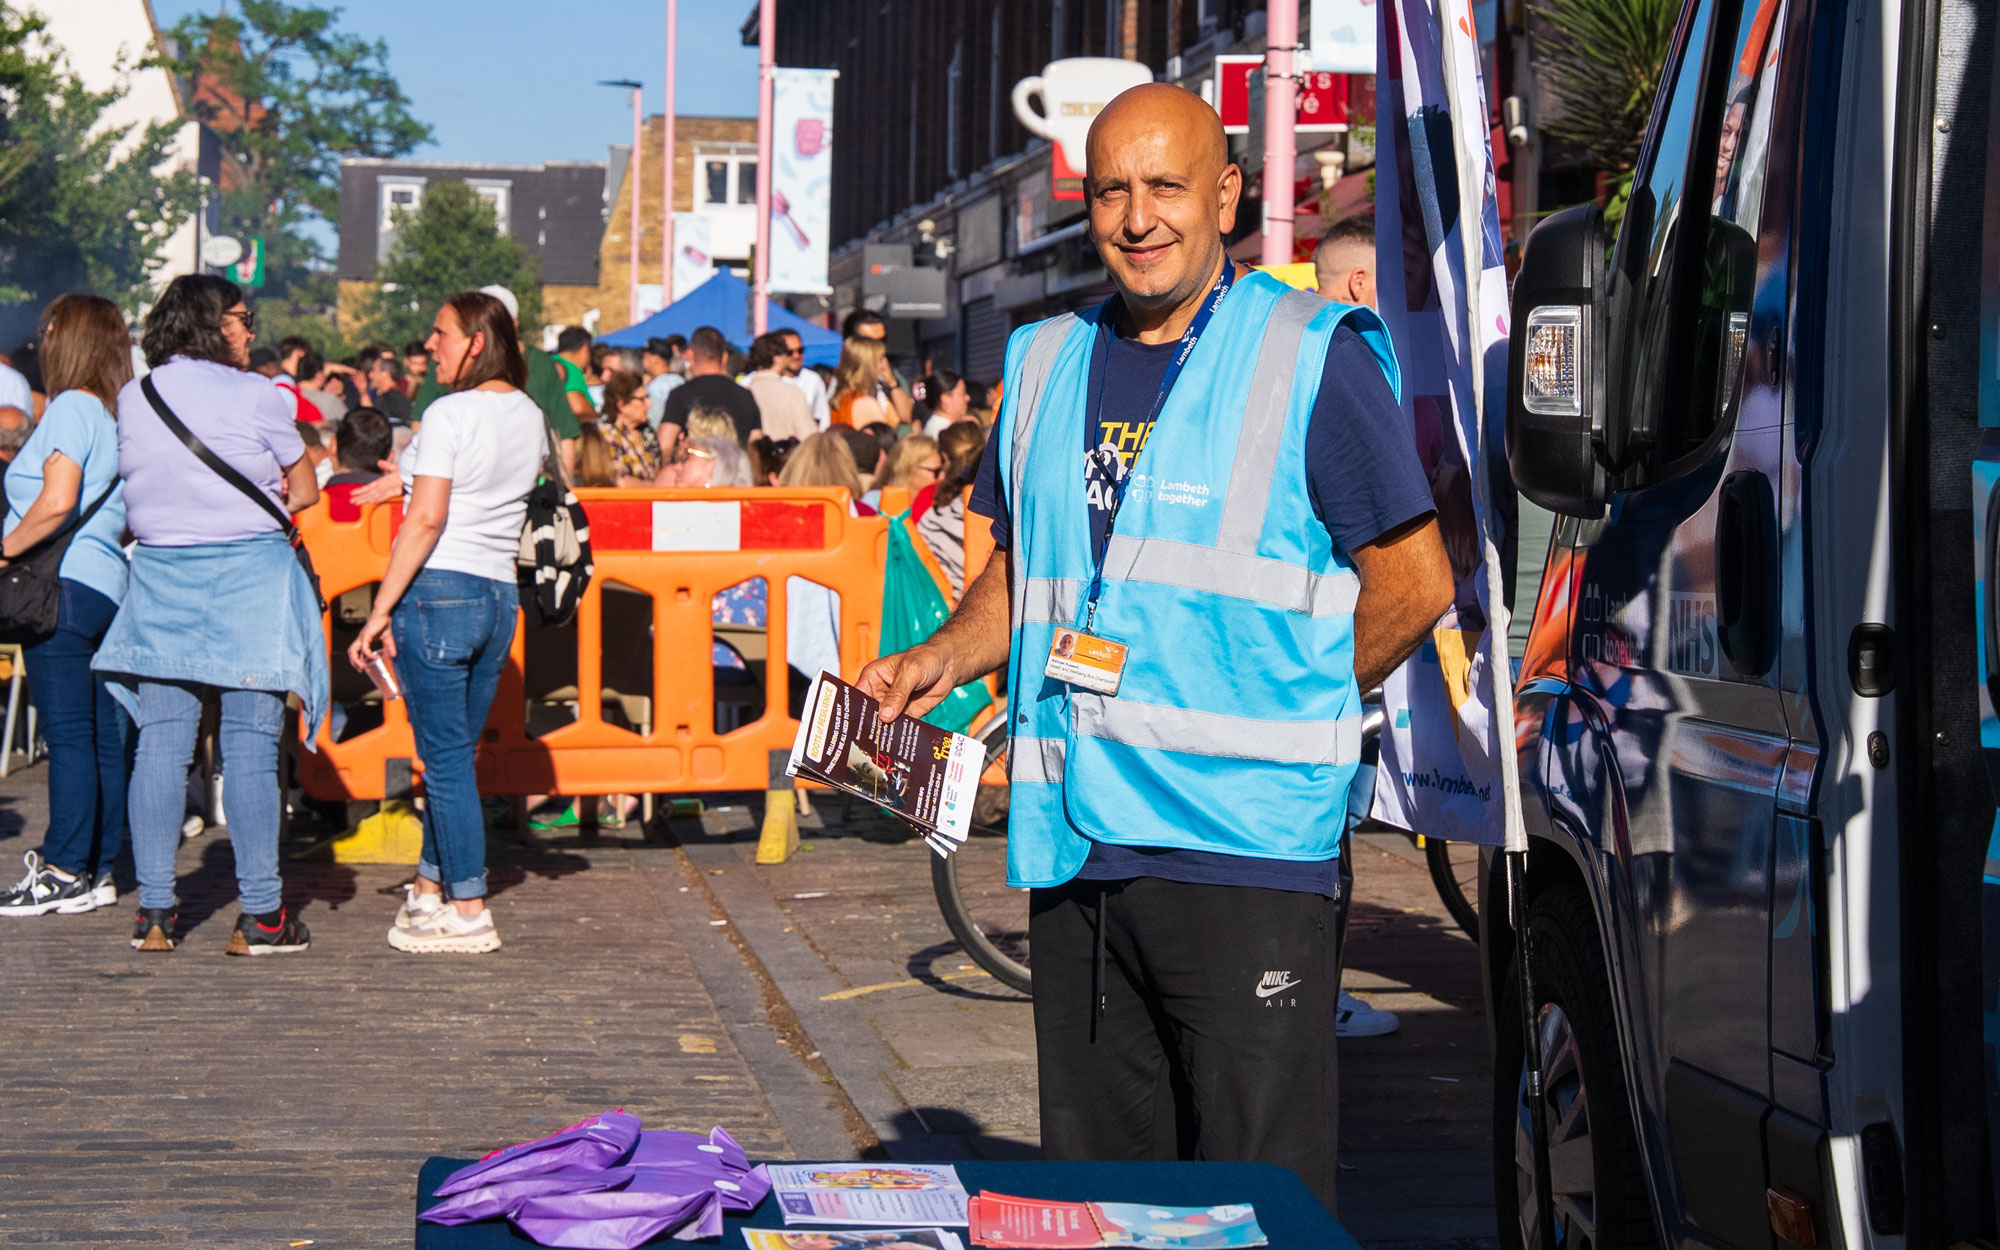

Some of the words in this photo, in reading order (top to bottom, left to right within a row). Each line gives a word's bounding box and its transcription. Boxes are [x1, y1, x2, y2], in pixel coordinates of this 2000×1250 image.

[1209, 284, 1230, 313] Lambeth
[1176, 336, 1198, 366] Lambeth
[1157, 491, 1208, 508] together
[1160, 479, 1210, 496] Lambeth
[1605, 592, 1645, 624] Lamb
[1604, 631, 1644, 667] together
[1668, 599, 1715, 675] NHS
[819, 687, 833, 727] RESILIENCE
[816, 726, 823, 736] of
[824, 748, 842, 775] SOMETIMES
[838, 740, 845, 751] WE
[844, 712, 849, 720] TO
[825, 730, 839, 756] WELLBEING
[811, 736, 822, 758] ROOTS
[1262, 970, 1291, 986] NIKE
[1265, 998, 1297, 1008] AIR
